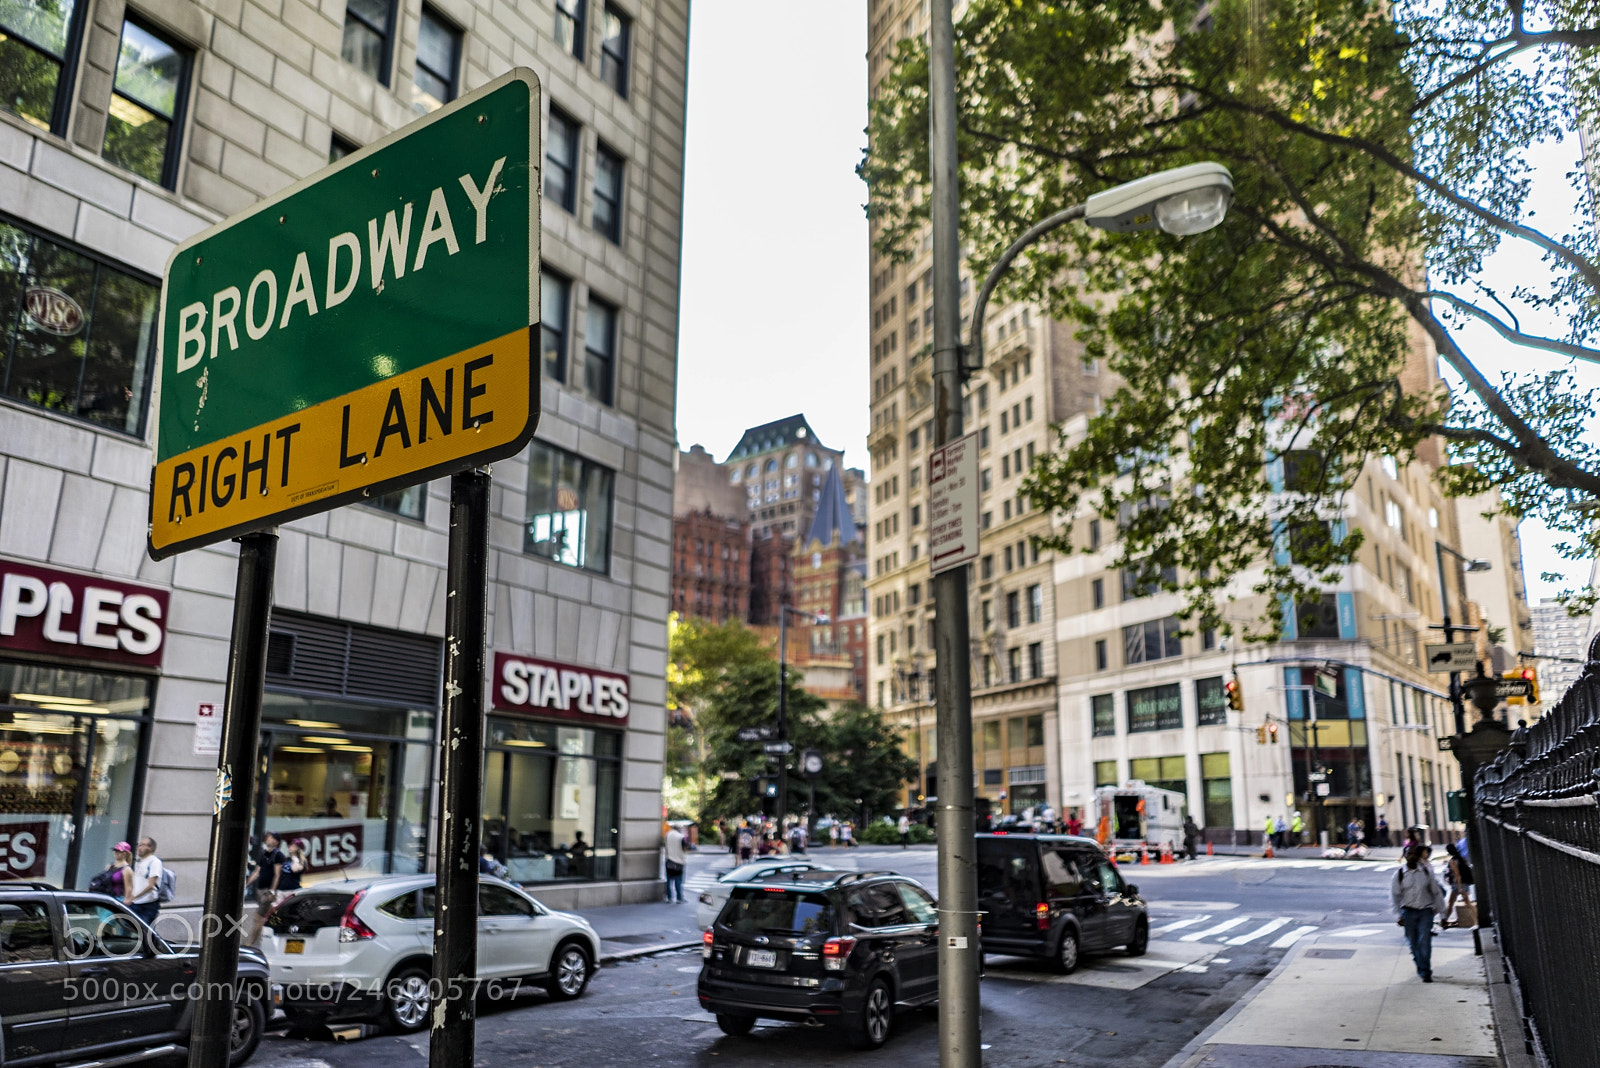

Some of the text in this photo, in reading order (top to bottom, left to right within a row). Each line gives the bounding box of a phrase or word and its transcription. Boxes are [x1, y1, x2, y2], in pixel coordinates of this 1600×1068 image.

[177, 156, 507, 374] BROADWAY
[168, 354, 494, 522] RIGHT LANE
[501, 659, 629, 718] STAPLES
